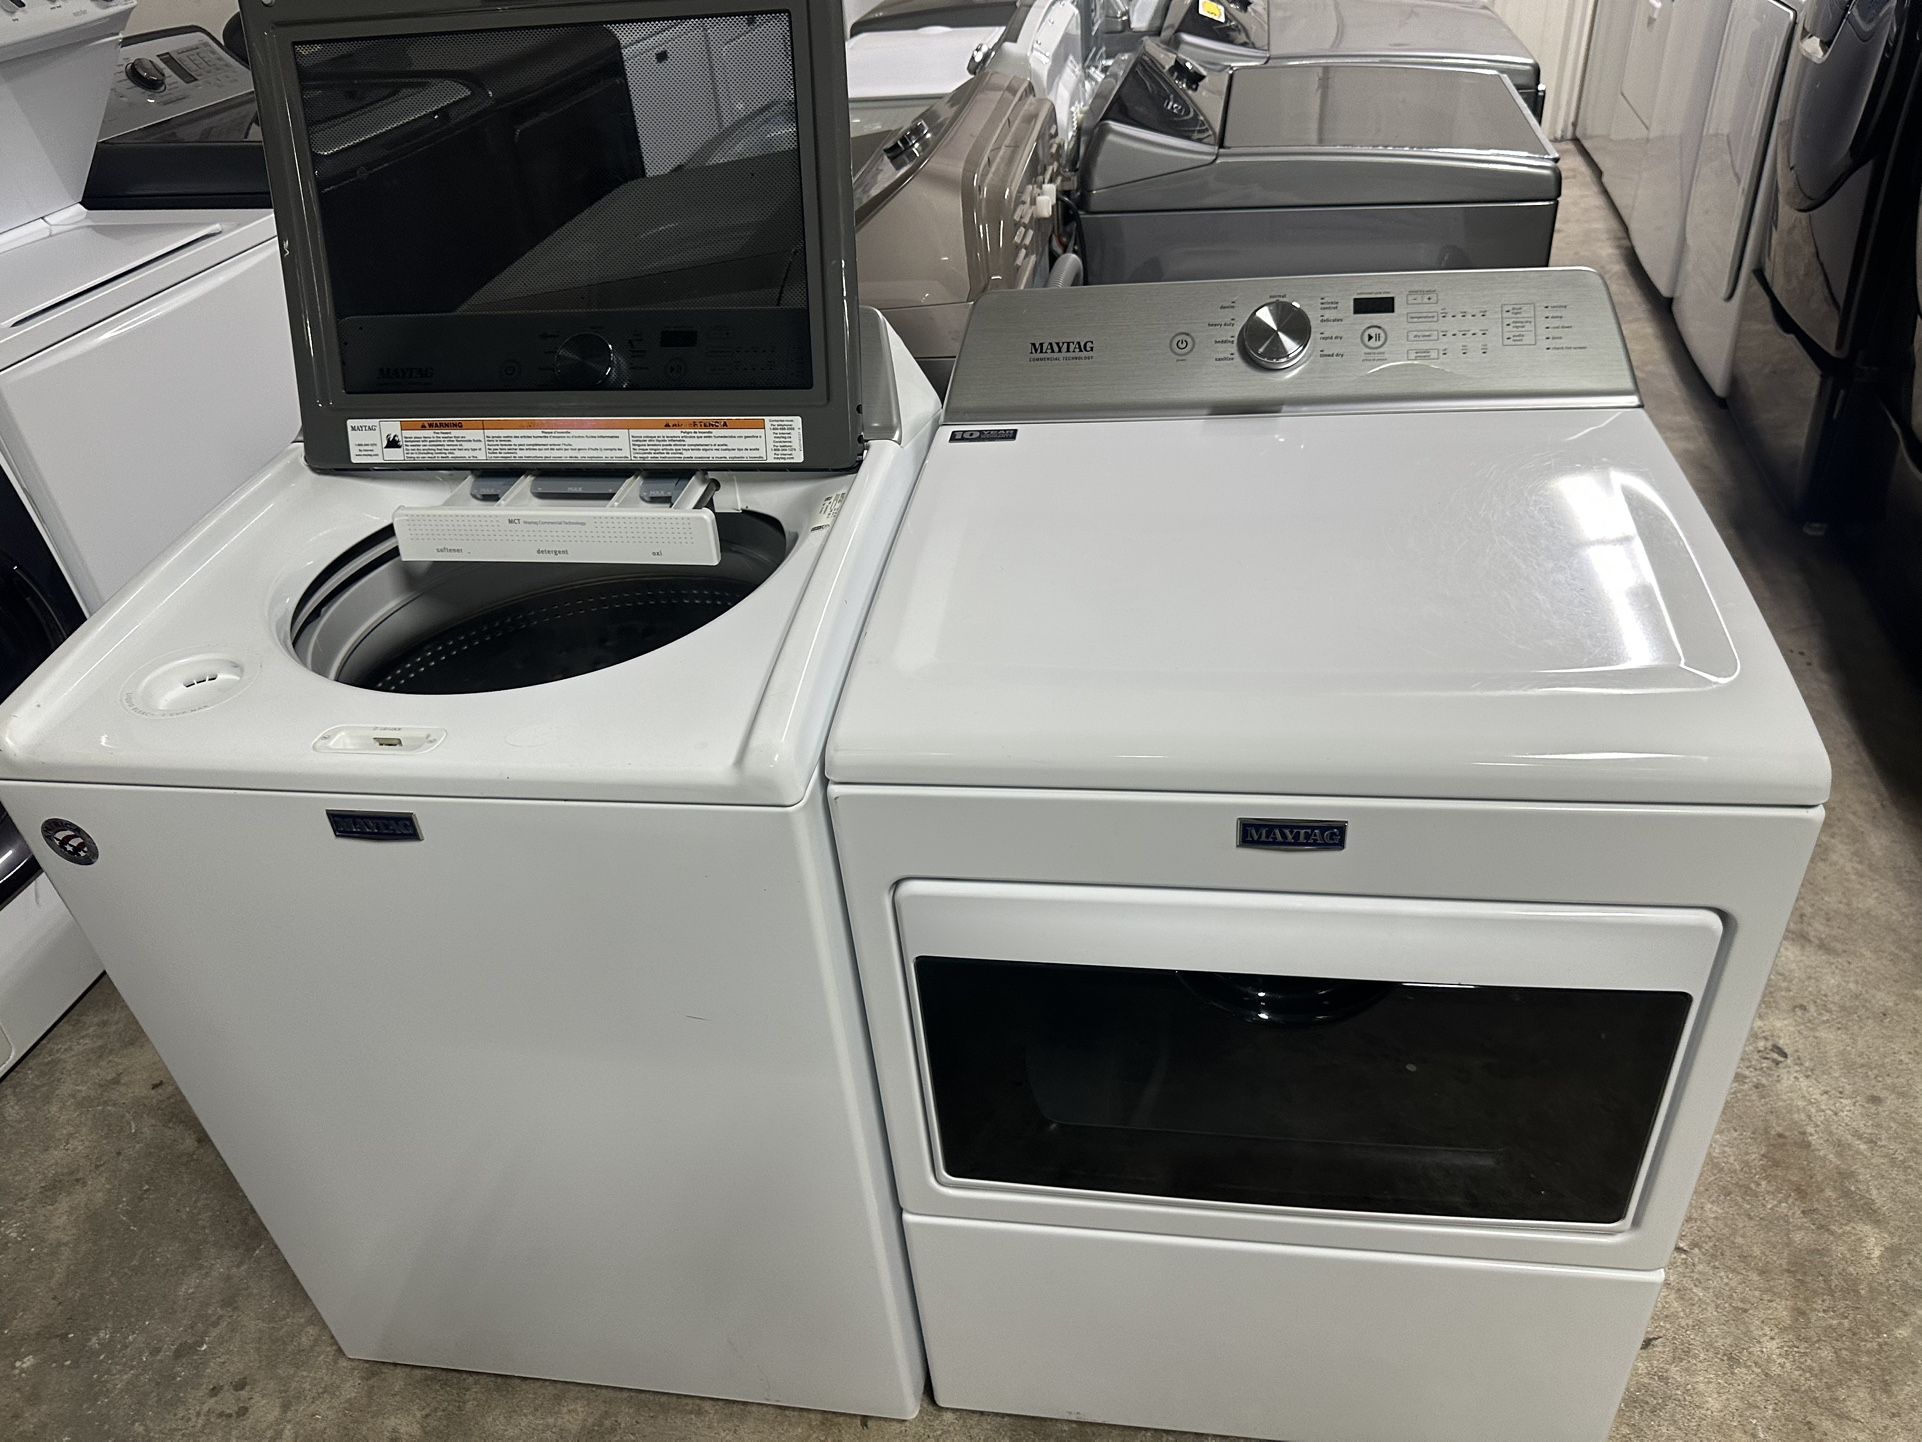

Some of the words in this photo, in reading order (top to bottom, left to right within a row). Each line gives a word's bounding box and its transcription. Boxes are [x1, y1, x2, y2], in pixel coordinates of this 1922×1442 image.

[1028, 340, 1094, 354] MAYTAG
[954, 431, 980, 440] 10
[1246, 826, 1340, 844] MAYTAG
